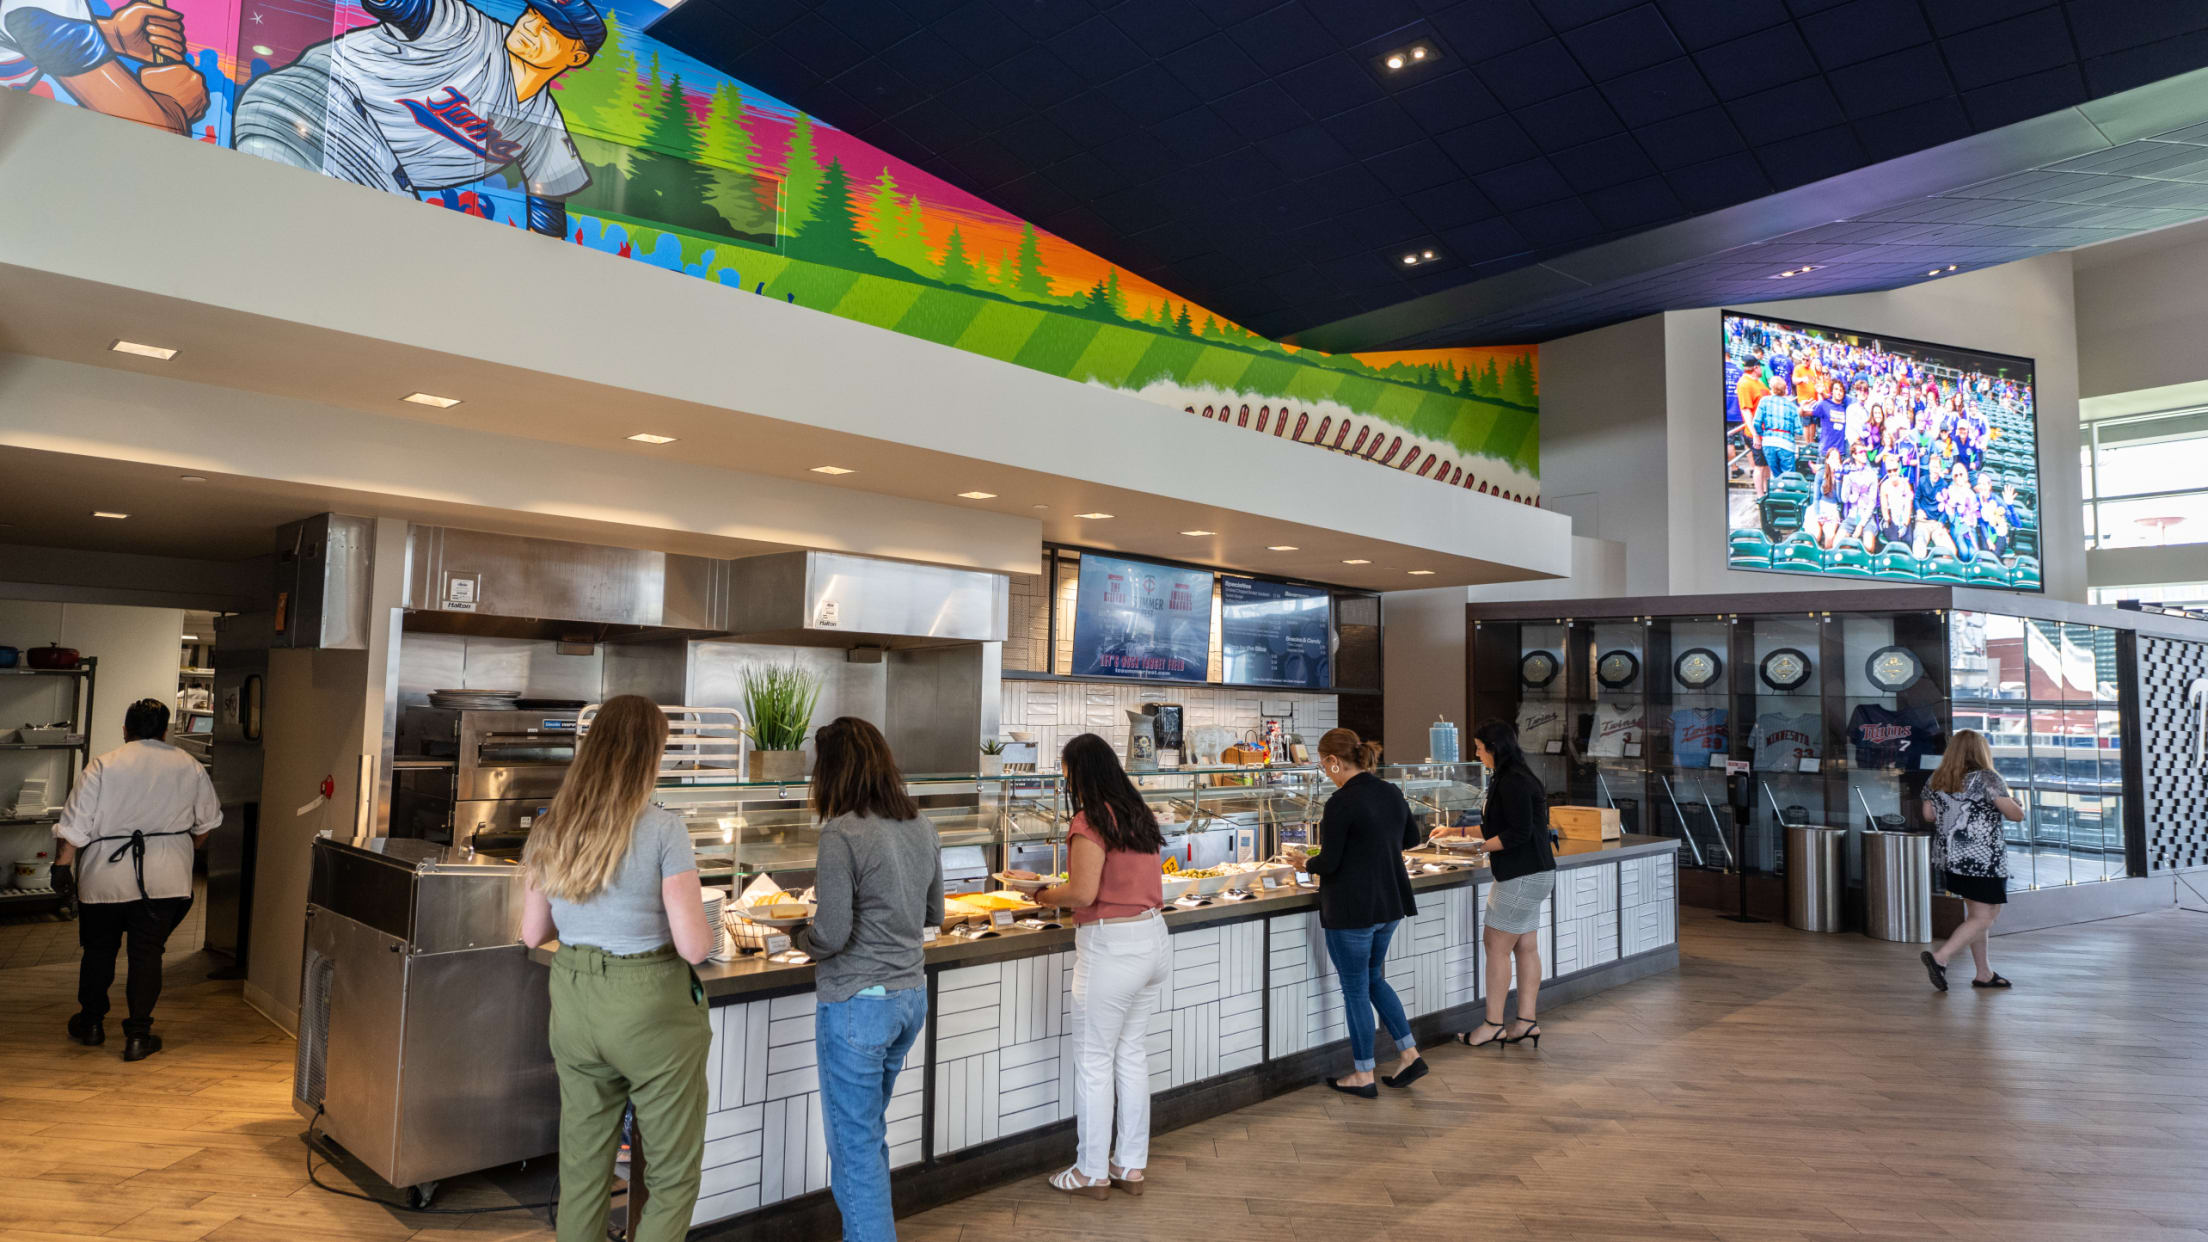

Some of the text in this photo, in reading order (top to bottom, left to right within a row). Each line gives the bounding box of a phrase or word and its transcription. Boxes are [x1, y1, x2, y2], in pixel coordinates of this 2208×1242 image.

[393, 86, 522, 164] Twins
[1526, 712, 1558, 731] Twins
[1600, 718, 1642, 736] Twins
[1622, 732, 1632, 743] 3
[1766, 730, 1810, 746] MINNESOTA
[1859, 722, 1912, 743] Twins
[1792, 748, 1815, 758] 33
[1898, 740, 1911, 751] 7
[1165, 861, 1177, 874] 12
